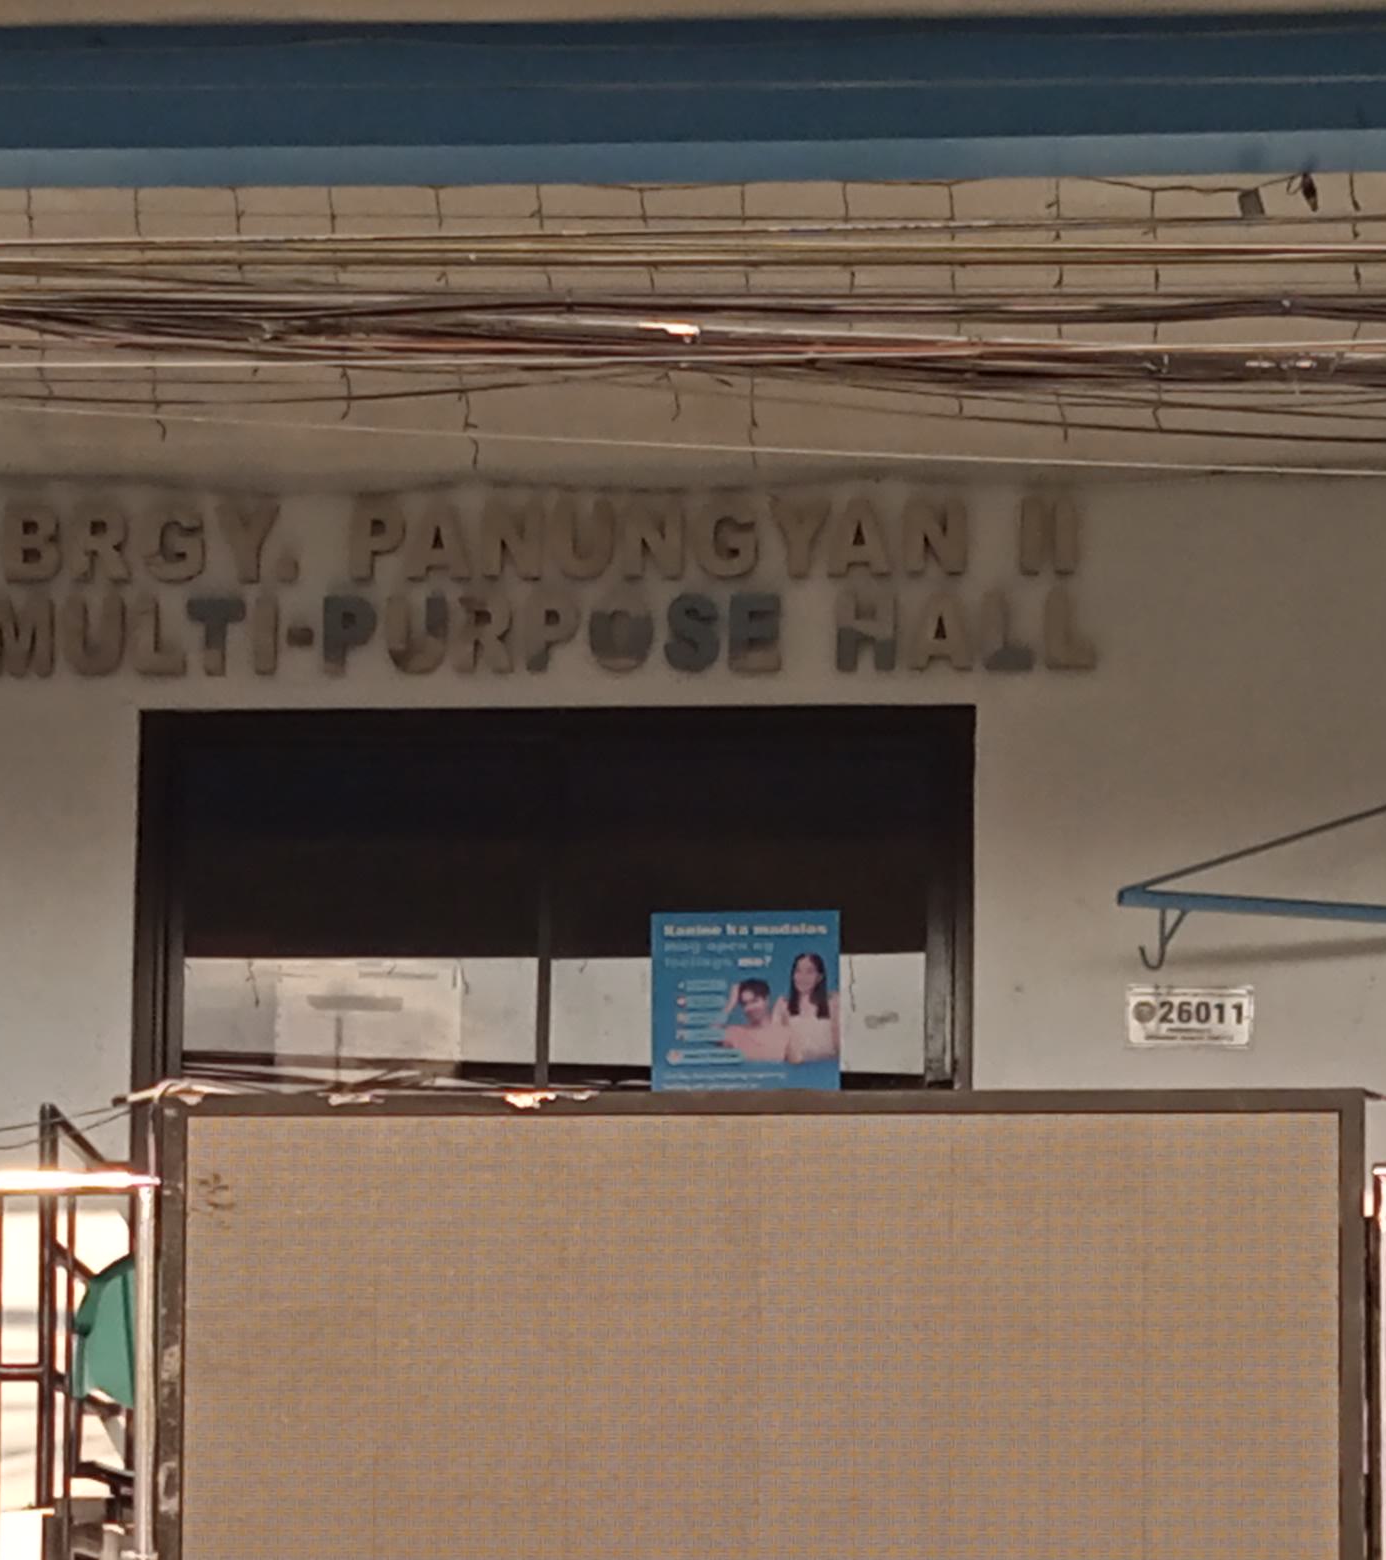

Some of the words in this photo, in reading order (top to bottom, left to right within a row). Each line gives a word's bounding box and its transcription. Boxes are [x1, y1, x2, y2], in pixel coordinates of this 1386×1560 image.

[2, 496, 300, 584] BRGY.
[348, 495, 969, 582] PANUNGYAN
[834, 592, 1097, 674] HALL
[1158, 1001, 1244, 1025] 26011
